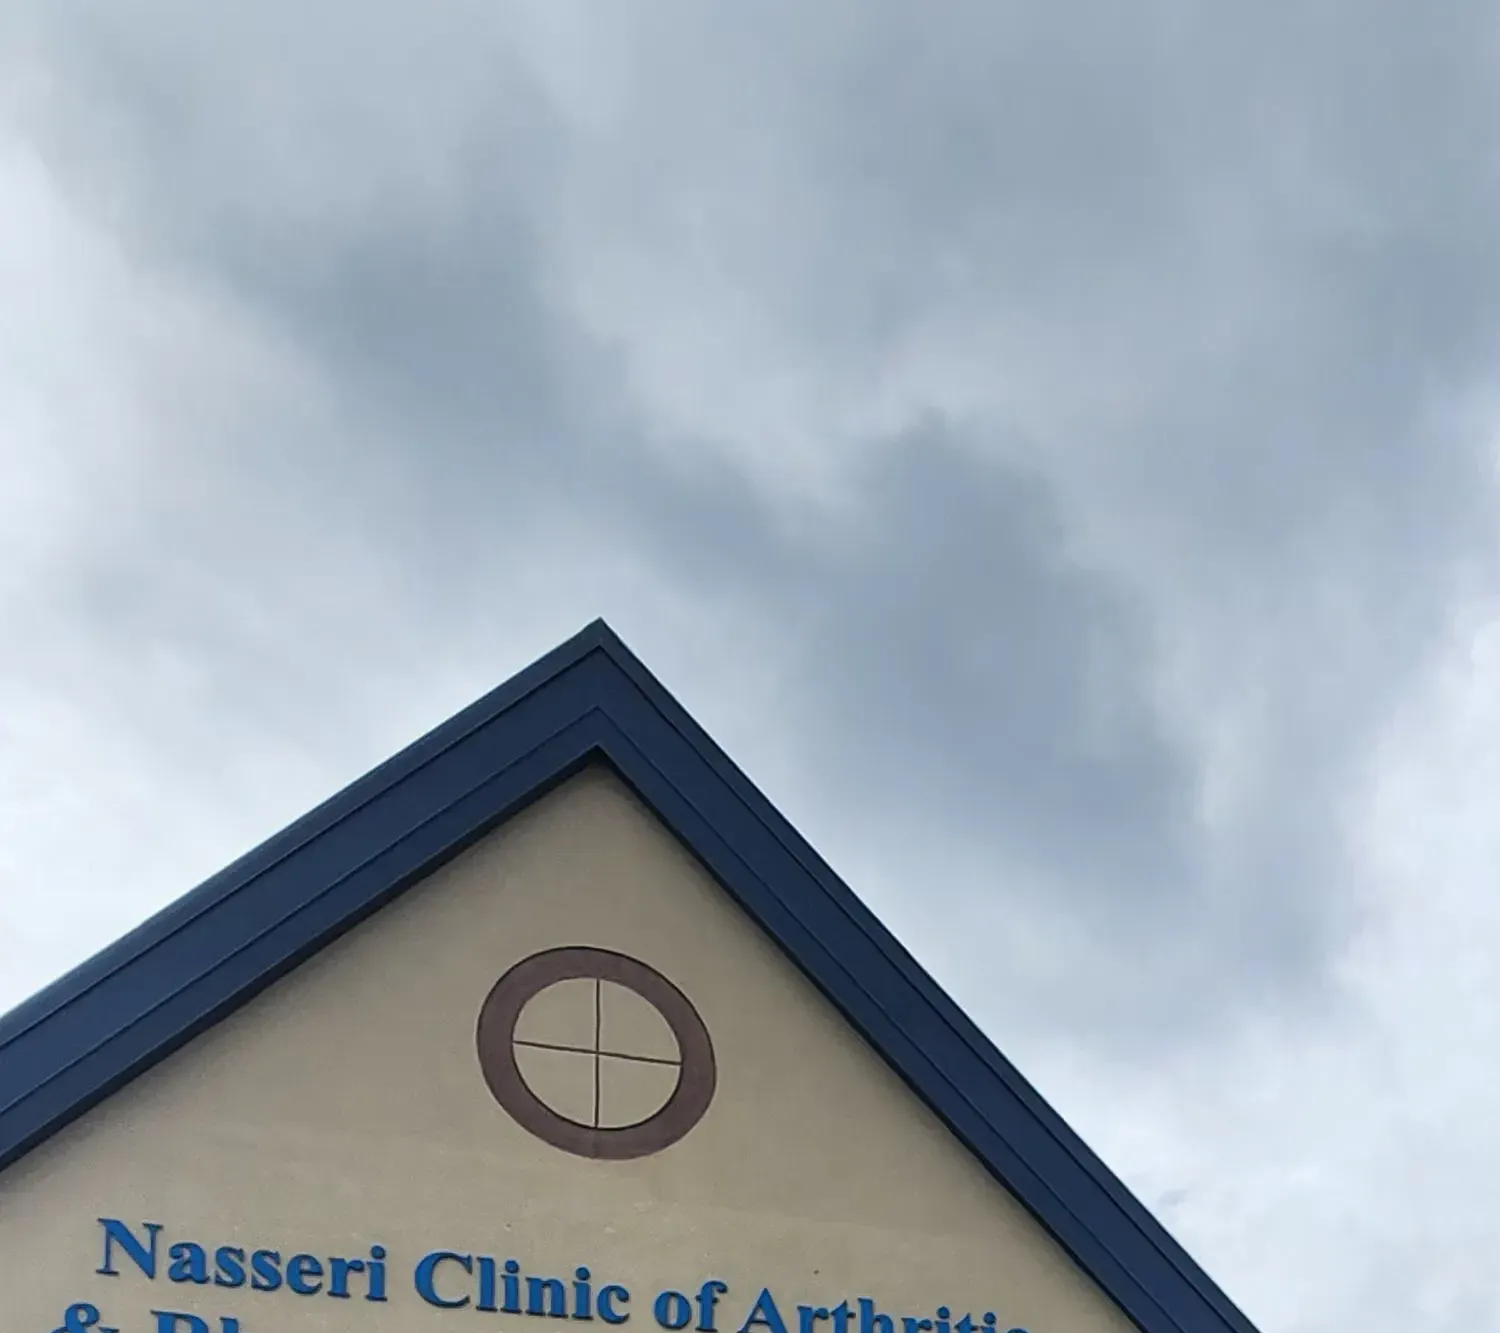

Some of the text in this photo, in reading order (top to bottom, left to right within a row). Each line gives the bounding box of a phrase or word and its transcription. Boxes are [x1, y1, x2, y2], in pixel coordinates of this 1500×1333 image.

[98, 1217, 388, 1303] Nasseri
[413, 1249, 630, 1324] Clinic
[652, 1279, 728, 1333] of
